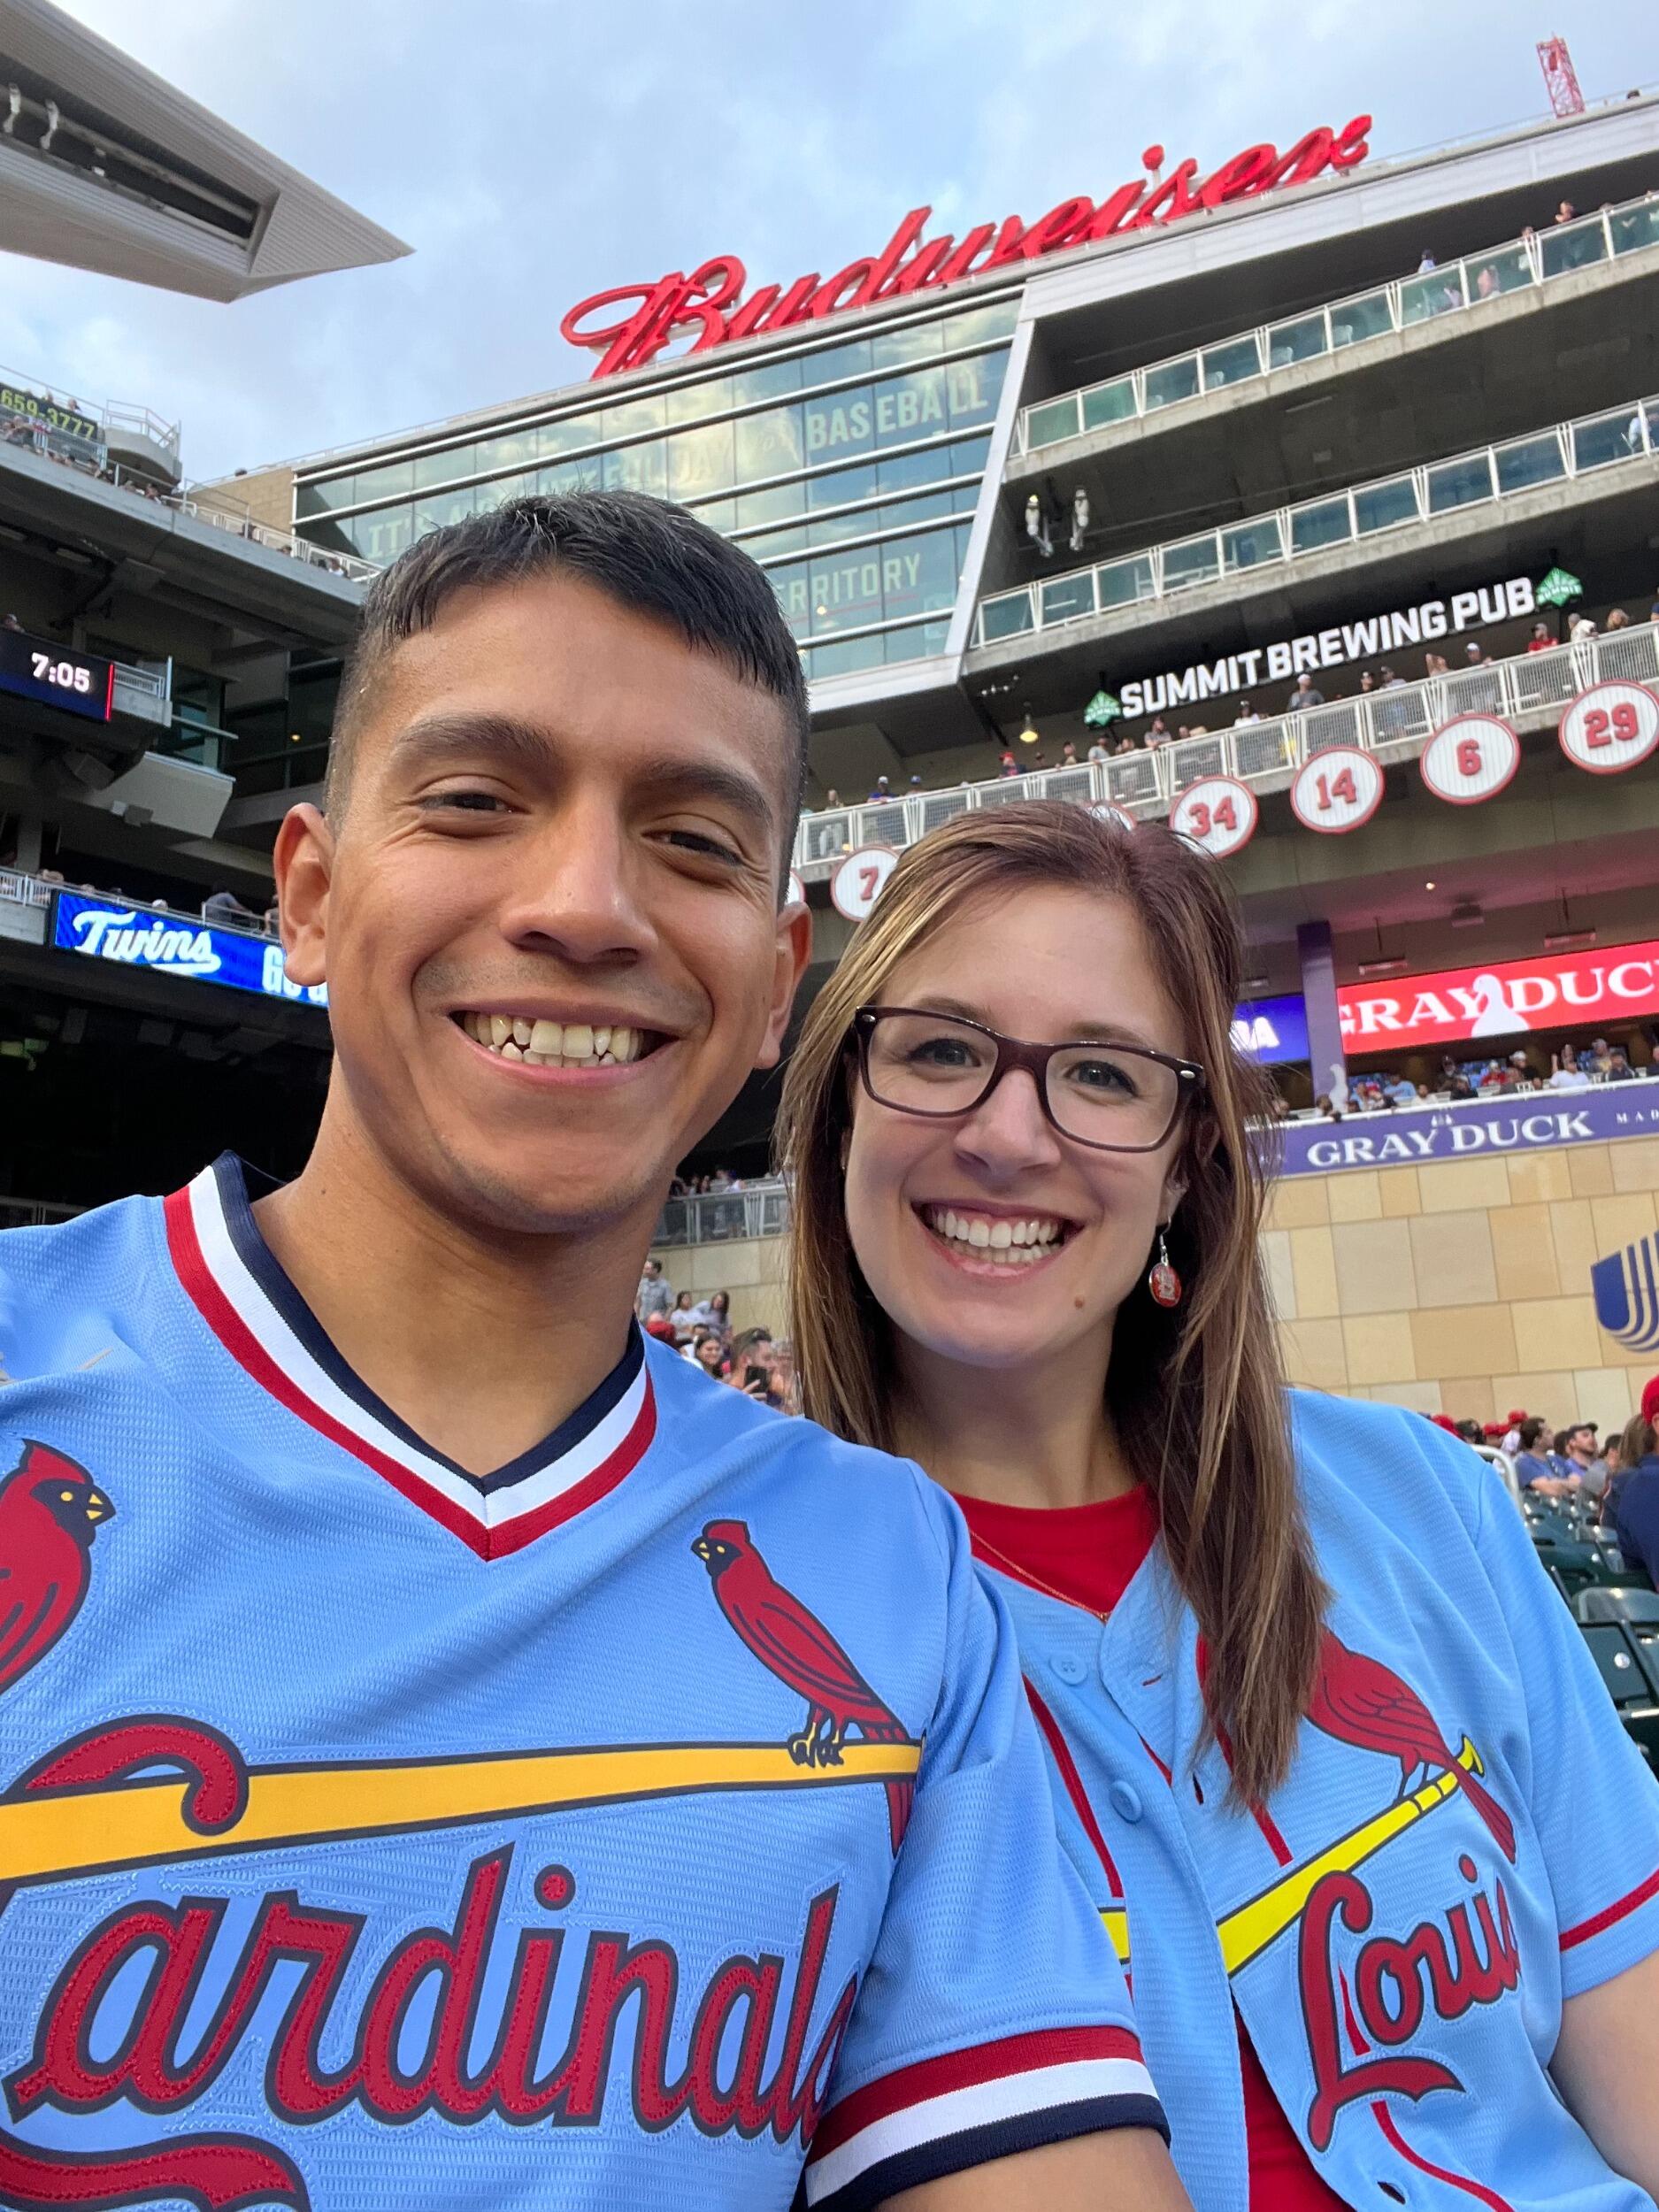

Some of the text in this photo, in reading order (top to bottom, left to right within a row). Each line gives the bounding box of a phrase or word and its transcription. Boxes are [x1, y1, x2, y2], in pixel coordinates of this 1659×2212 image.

[560, 114, 1372, 379] Budweiser
[1, 389, 95, 441] 659-3777
[805, 373, 988, 450] BASEBALL
[31, 652, 90, 693] 7:05
[1120, 577, 1535, 718] SUMMIT BREWING PUB
[1584, 701, 1639, 749] 29
[1456, 738, 1481, 776] 6
[1316, 767, 1356, 810] 14
[1189, 795, 1237, 837] 34
[859, 866, 879, 901] 7
[73, 910, 221, 976] Twins
[1505, 959, 1659, 1012] DUC
[1307, 1127, 1439, 1167] GRAY
[1449, 1110, 1593, 1150] DUCK
